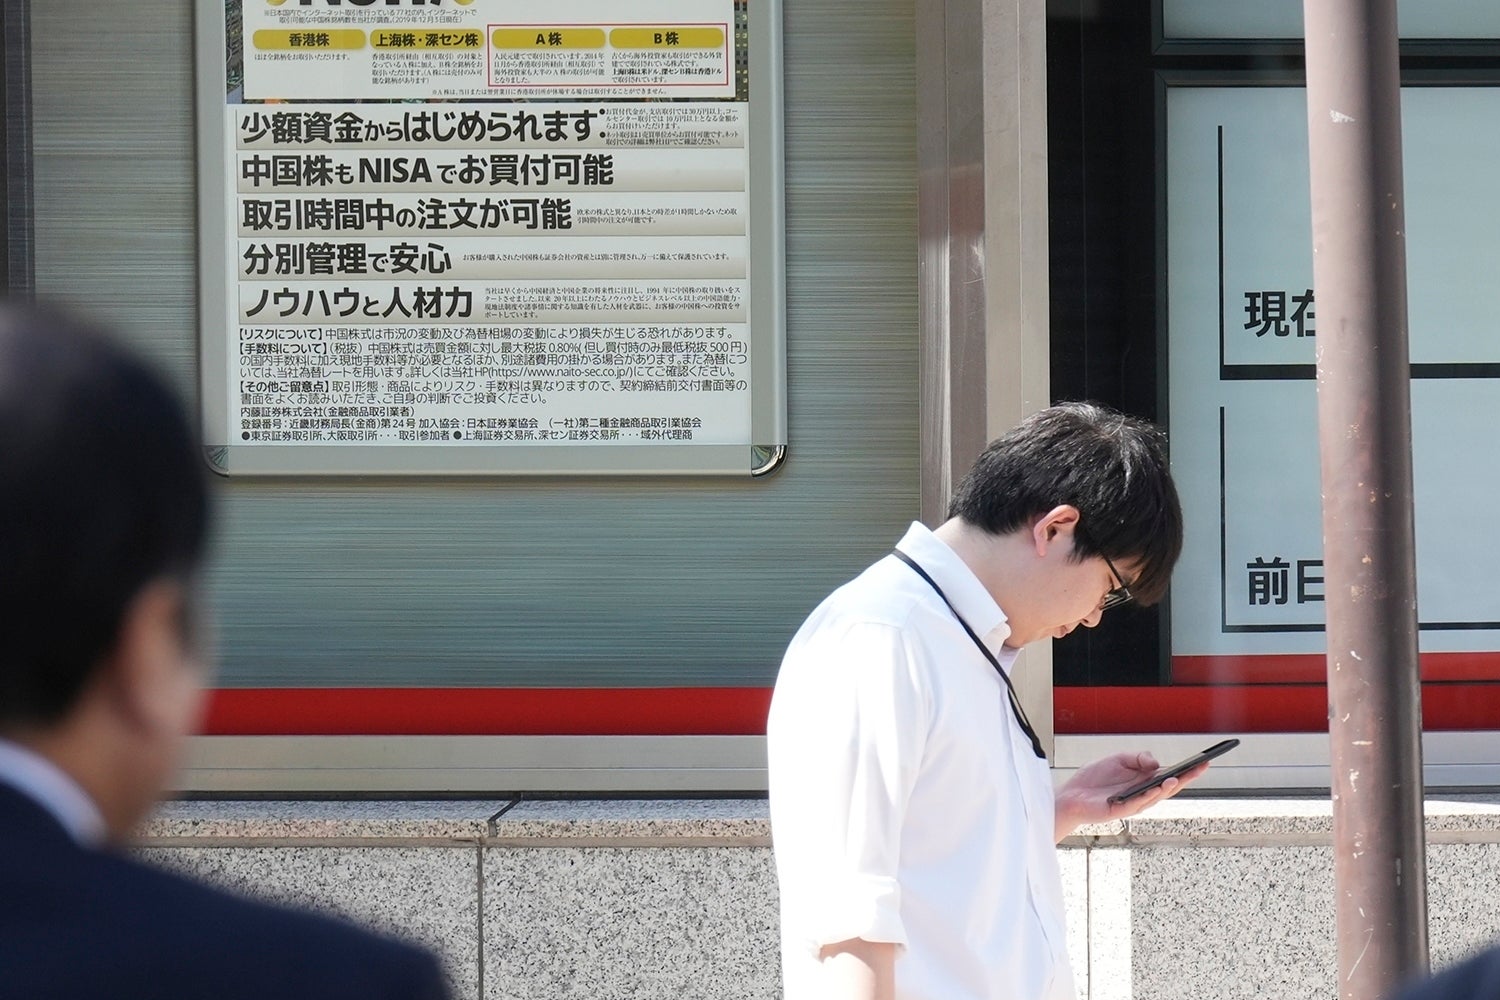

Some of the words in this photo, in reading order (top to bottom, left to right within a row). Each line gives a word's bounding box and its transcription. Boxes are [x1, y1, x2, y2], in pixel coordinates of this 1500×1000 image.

[289, 33, 330, 47] 香港株
[375, 33, 479, 47] 上海株・深セン株
[535, 32, 562, 46] A株
[654, 31, 679, 45] B株
[241, 109, 597, 144] 少額資金からはじめられます
[242, 197, 572, 231] 取引時間中の注文が可能
[243, 242, 452, 276] 分別管理で安心
[246, 286, 473, 319] ノウハウと人材力
